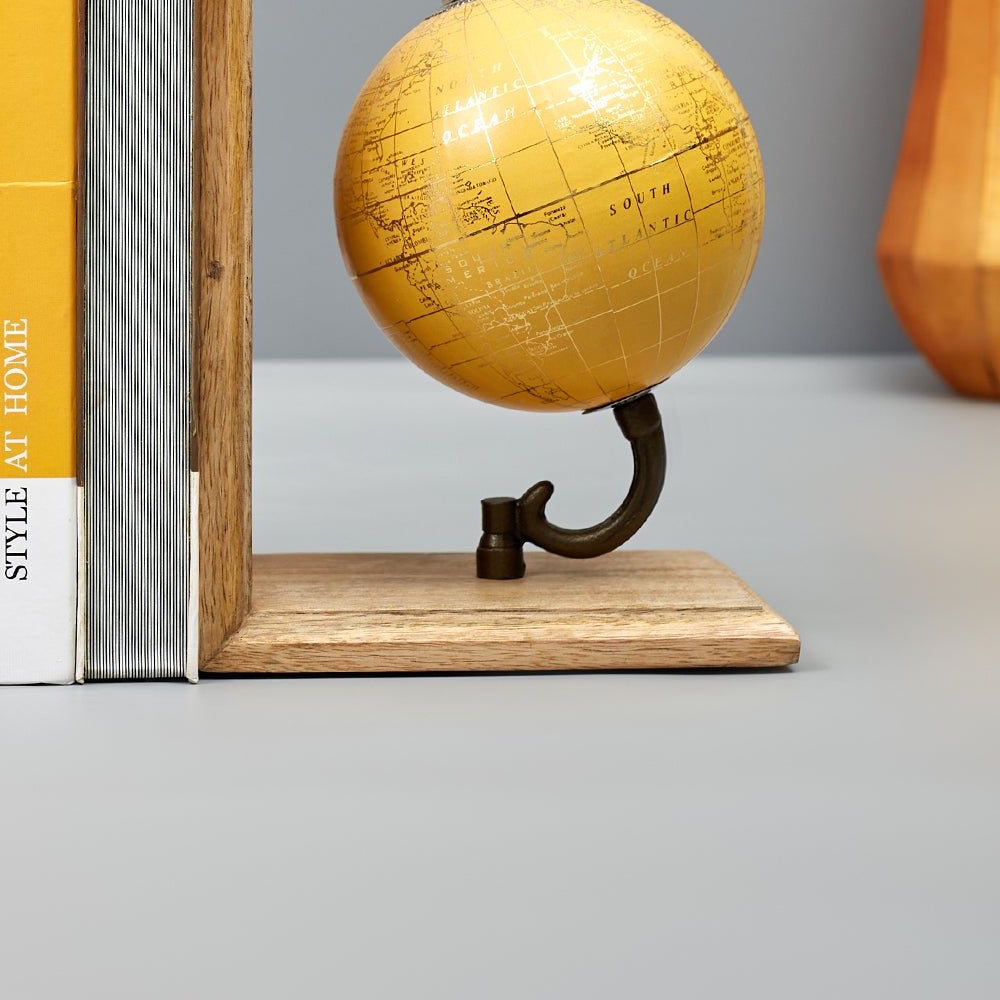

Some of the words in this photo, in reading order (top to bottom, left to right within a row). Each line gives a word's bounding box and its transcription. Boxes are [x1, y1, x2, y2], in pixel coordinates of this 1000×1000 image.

[609, 183, 670, 216] SOUTH
[594, 209, 692, 258] ATLANTIC
[3, 318, 28, 416] HOME
[4, 431, 28, 473] AT
[4, 487, 28, 581] STYLE
